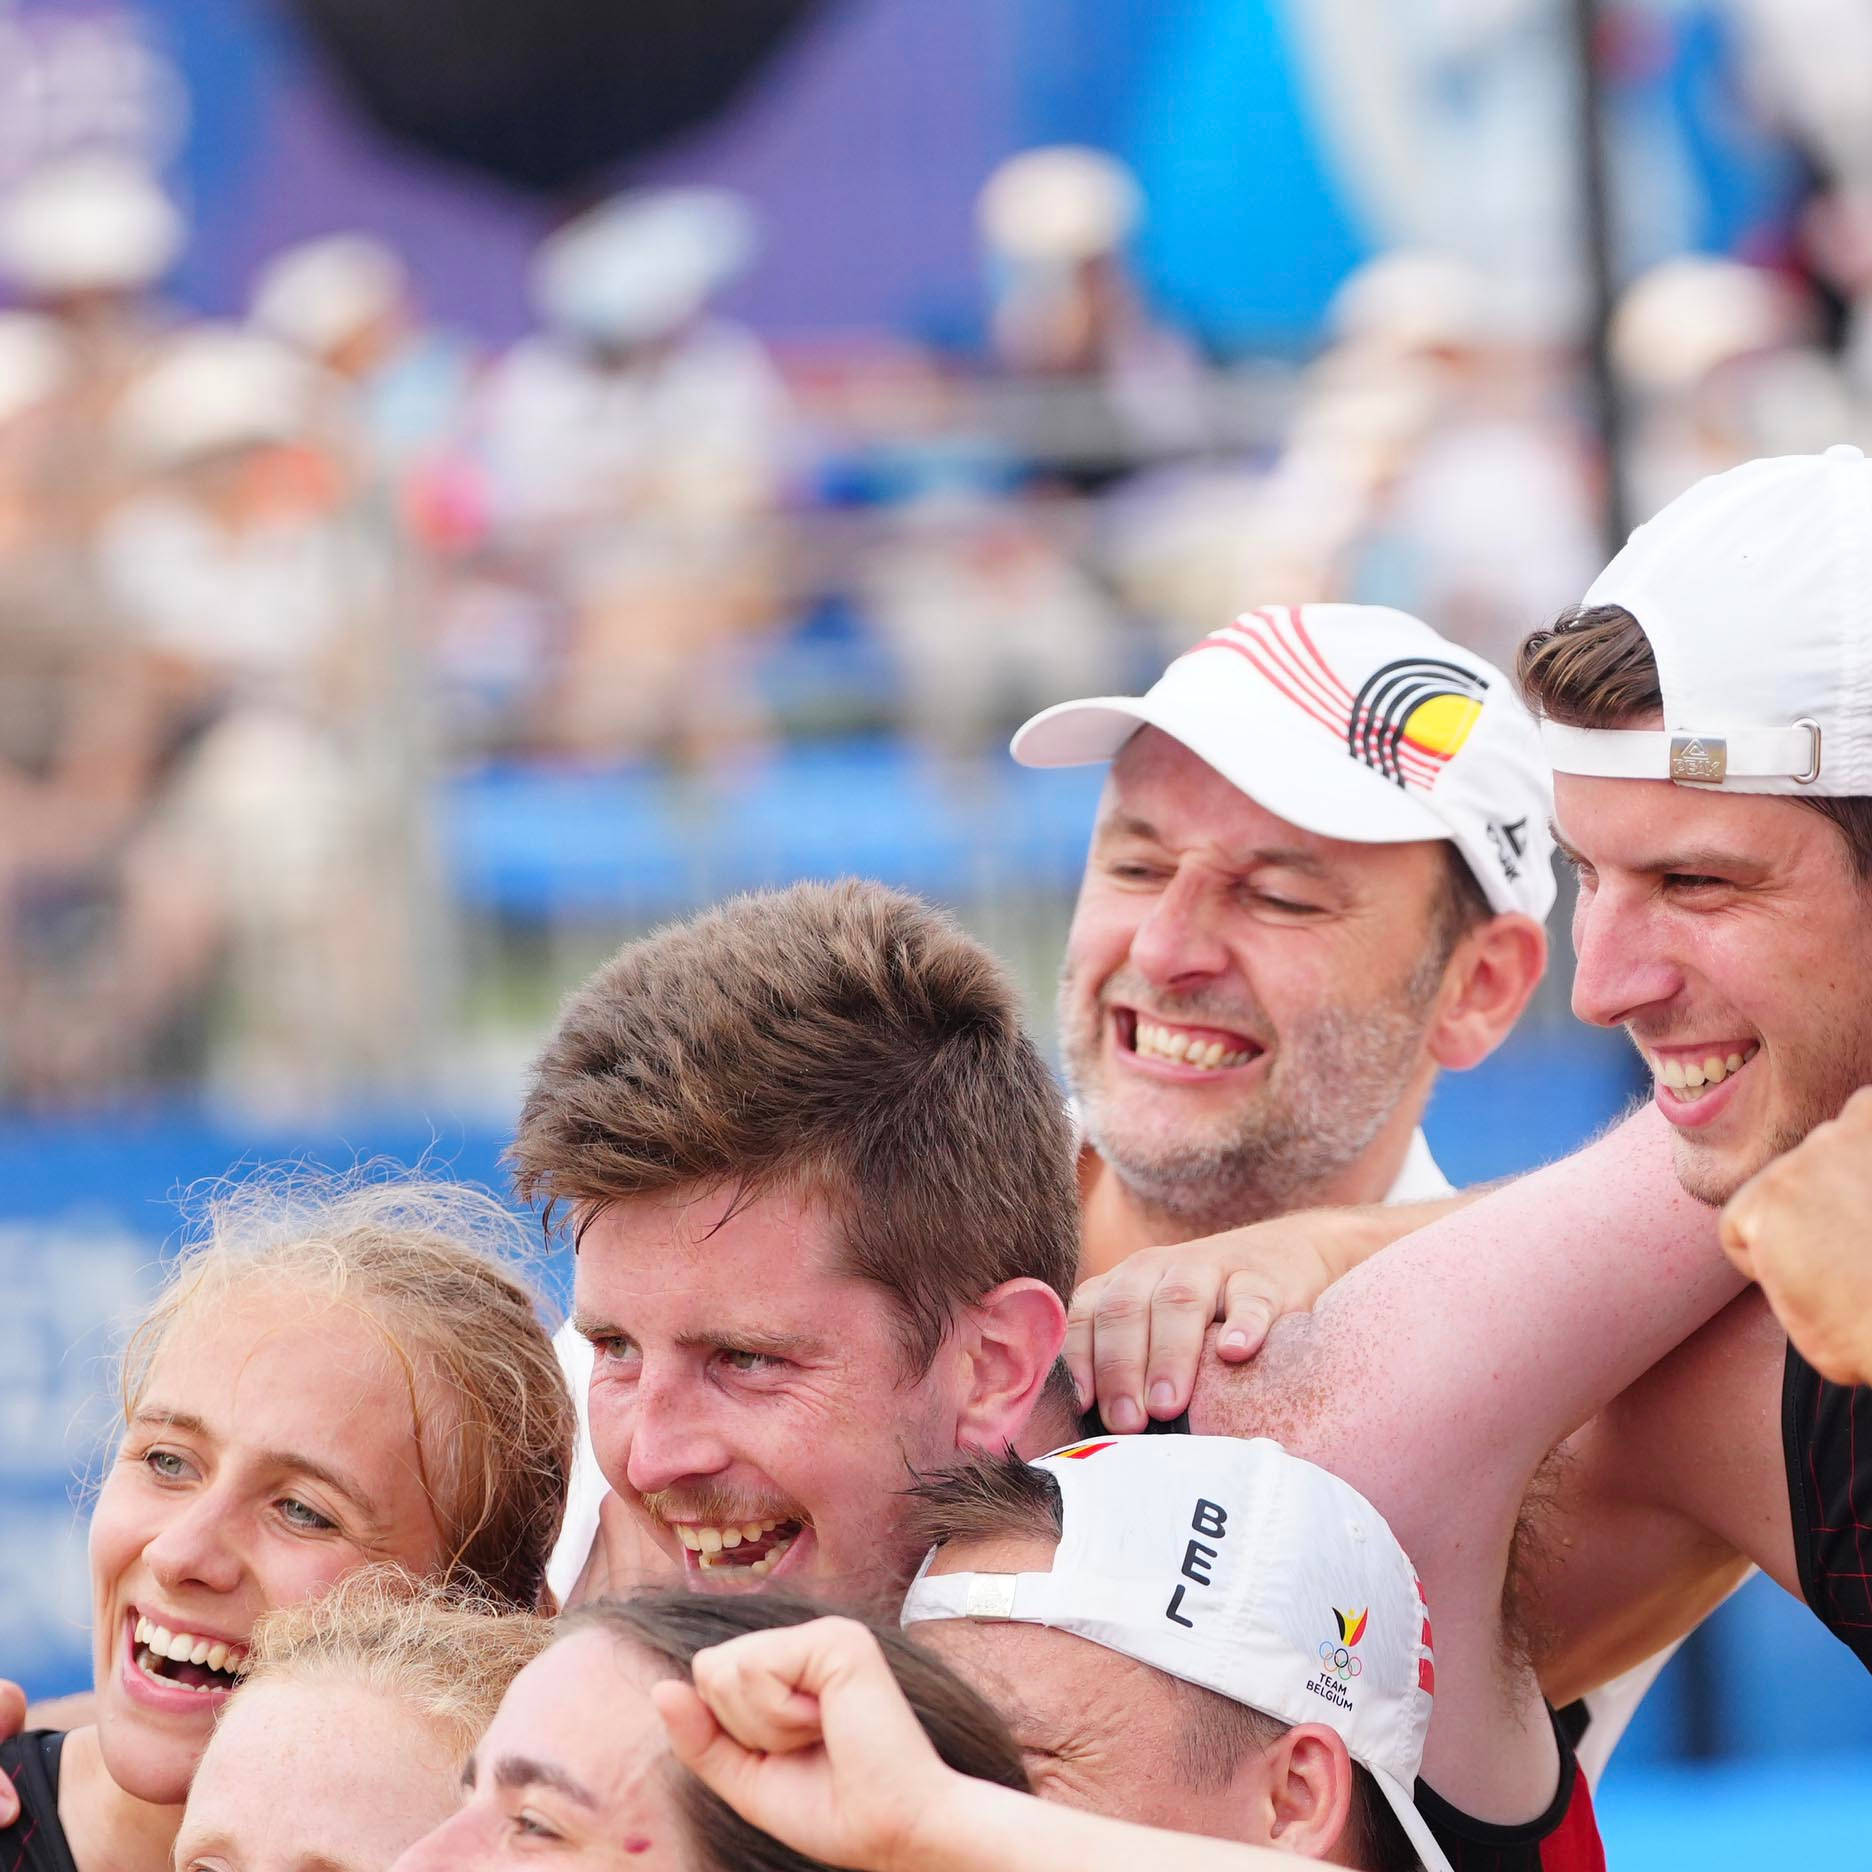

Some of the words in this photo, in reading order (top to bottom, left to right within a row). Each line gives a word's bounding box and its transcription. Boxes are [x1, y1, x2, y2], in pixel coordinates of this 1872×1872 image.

[1165, 1497, 1228, 1629] BEL
[1305, 1679, 1354, 1712] BELGIUM
[1319, 1672, 1348, 1696] TEAM
